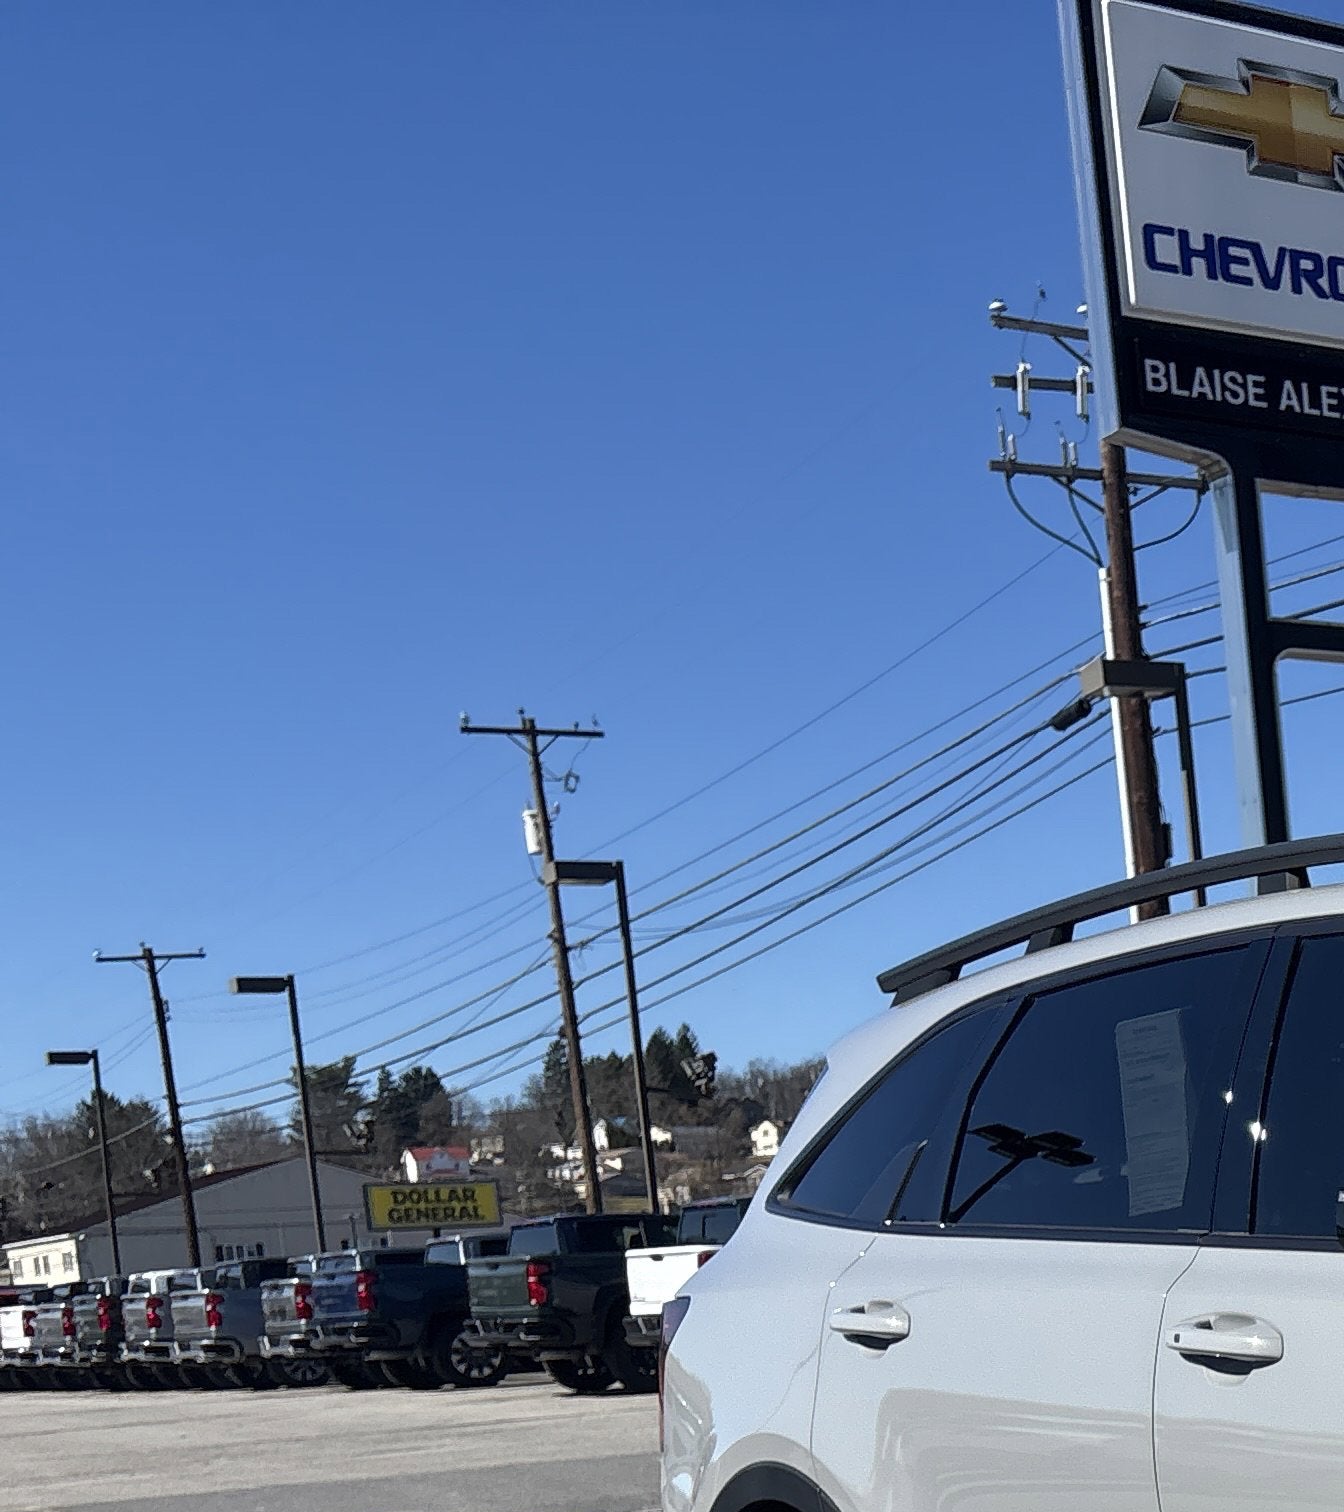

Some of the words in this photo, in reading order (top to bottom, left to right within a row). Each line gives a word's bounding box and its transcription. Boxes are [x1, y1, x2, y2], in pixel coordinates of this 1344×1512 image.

[1144, 359, 1268, 408] BLAISE
[390, 1187, 477, 1205] DOLLAR
[387, 1205, 486, 1224] GENERAL
